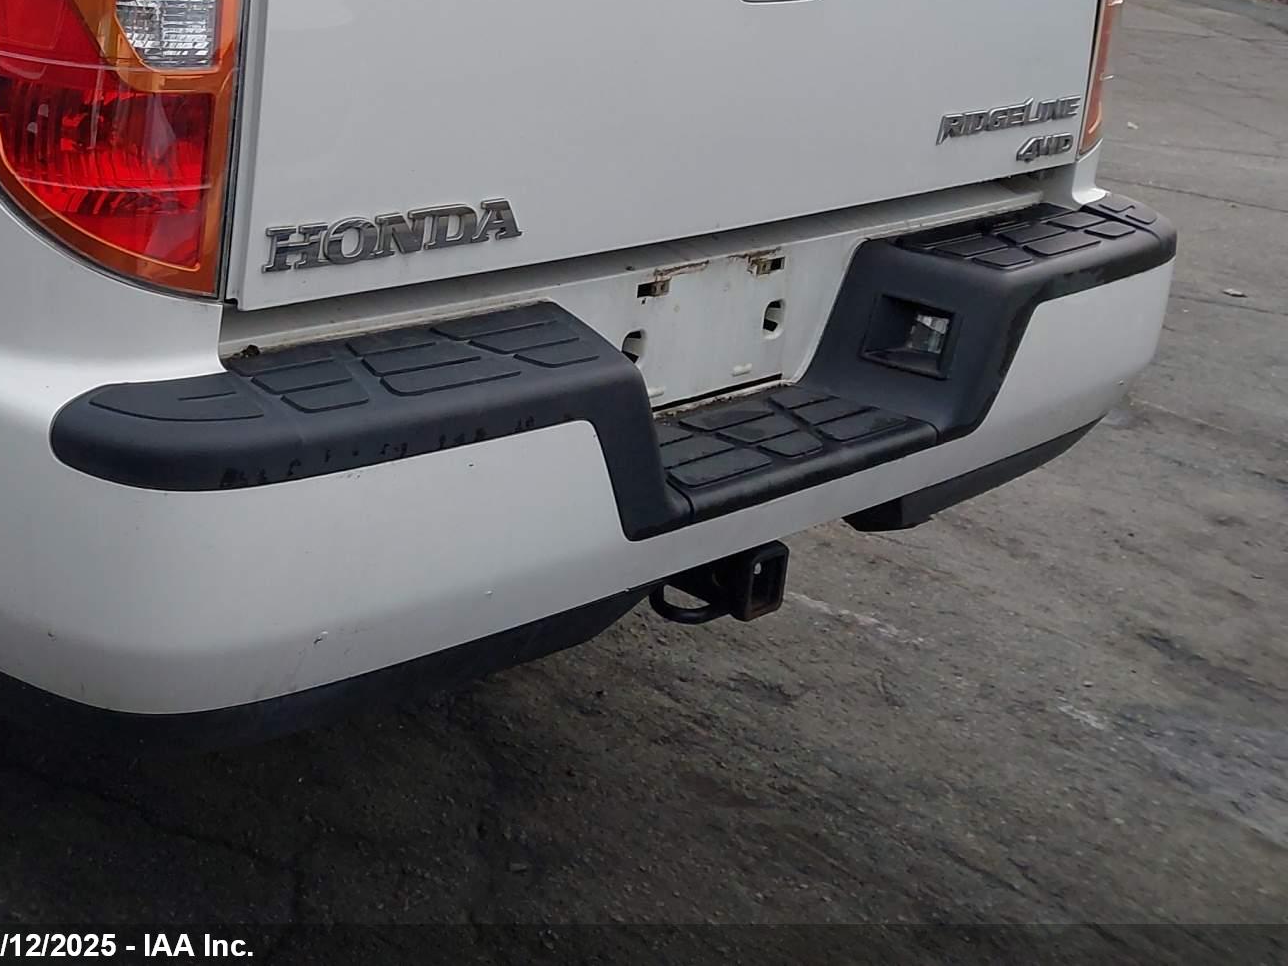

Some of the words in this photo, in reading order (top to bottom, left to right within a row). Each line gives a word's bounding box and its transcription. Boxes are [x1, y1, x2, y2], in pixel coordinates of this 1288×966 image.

[936, 96, 1081, 146] RIDGELINE
[1016, 133, 1074, 162] 4WD
[262, 197, 523, 273] HONDA
